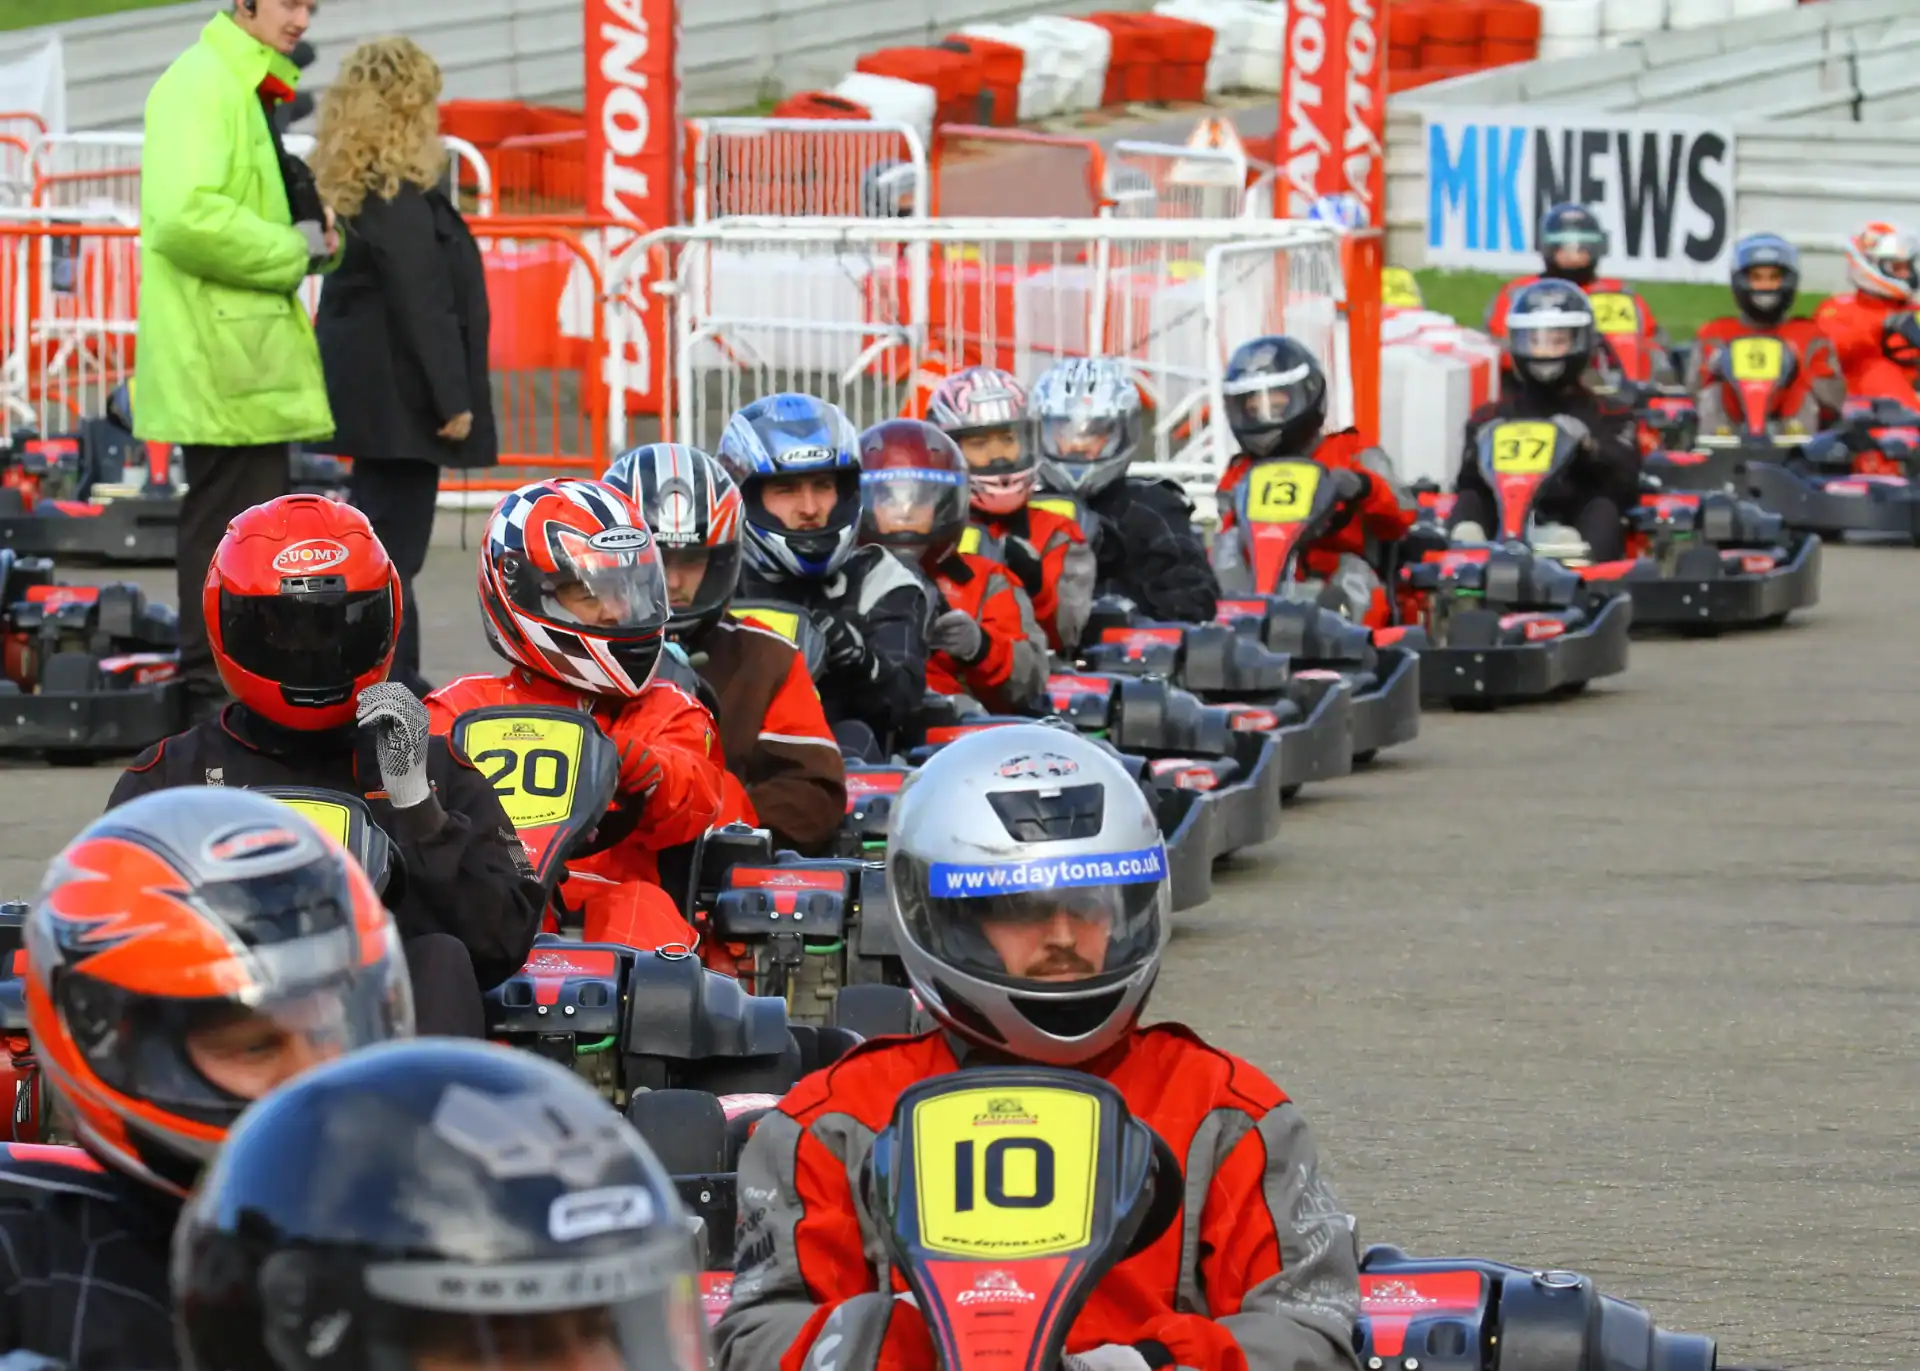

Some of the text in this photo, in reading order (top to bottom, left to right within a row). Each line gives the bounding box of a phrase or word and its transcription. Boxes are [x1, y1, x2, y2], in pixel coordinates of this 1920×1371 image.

[1499, 438, 1547, 460] 37
[1262, 481, 1298, 506] 13
[600, 533, 642, 544] KBC
[652, 531, 701, 544] SHARK
[279, 548, 343, 564] SUOMY
[473, 748, 570, 798] 20
[945, 851, 1161, 889] www.daytona.co.uk
[955, 1136, 1056, 1214] 10
[955, 1288, 1036, 1303] DAYTONA
